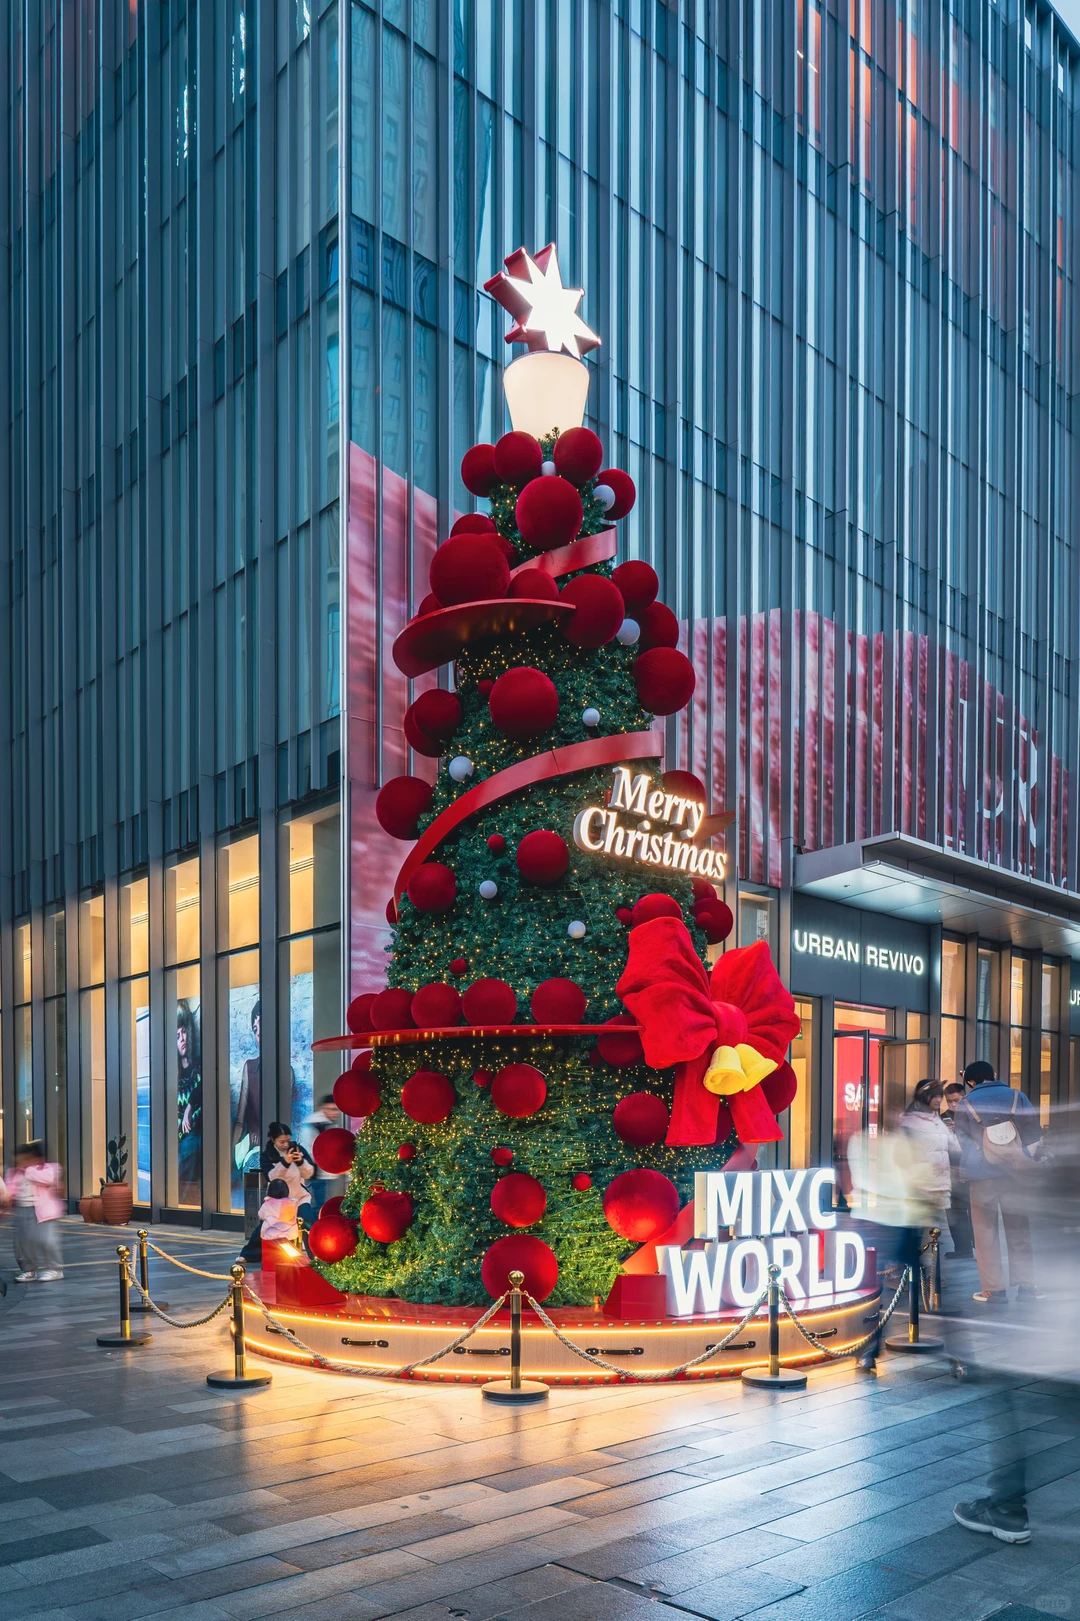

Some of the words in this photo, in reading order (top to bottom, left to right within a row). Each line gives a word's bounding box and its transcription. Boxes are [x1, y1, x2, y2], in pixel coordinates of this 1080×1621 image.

[608, 766, 704, 840] Merry
[574, 805, 728, 880] Christmas
[794, 929, 859, 963] URBAN
[866, 944, 924, 975] REVIVO
[702, 1168, 837, 1239] MIXC
[663, 1231, 866, 1316] WORLD
